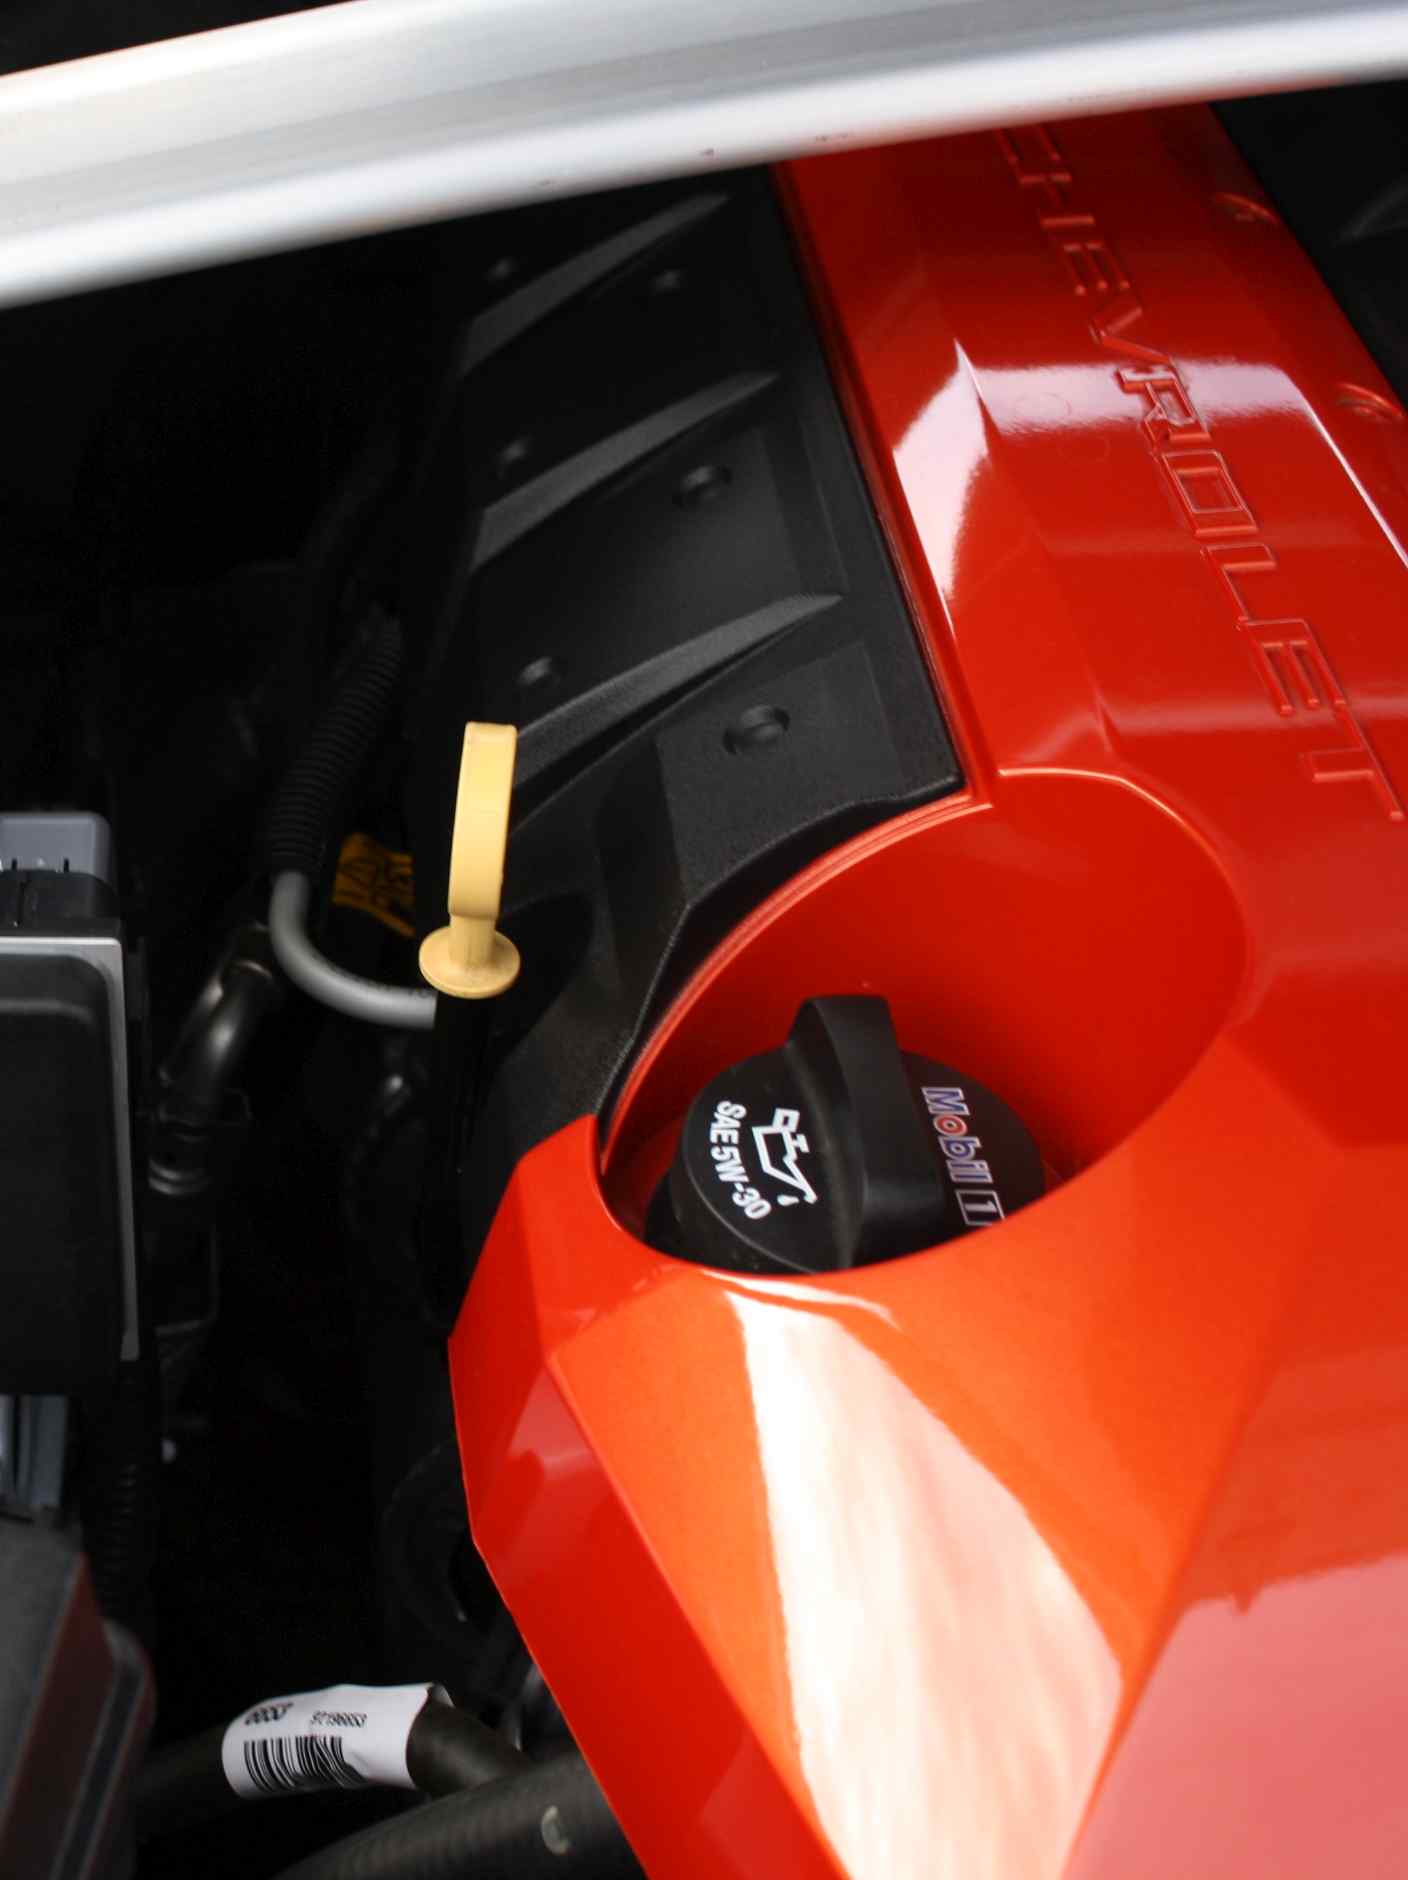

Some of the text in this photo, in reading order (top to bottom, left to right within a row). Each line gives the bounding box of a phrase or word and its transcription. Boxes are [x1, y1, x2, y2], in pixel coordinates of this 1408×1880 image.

[709, 1100, 772, 1220] SAE 5W-30
[921, 1086, 994, 1183] Mobil
